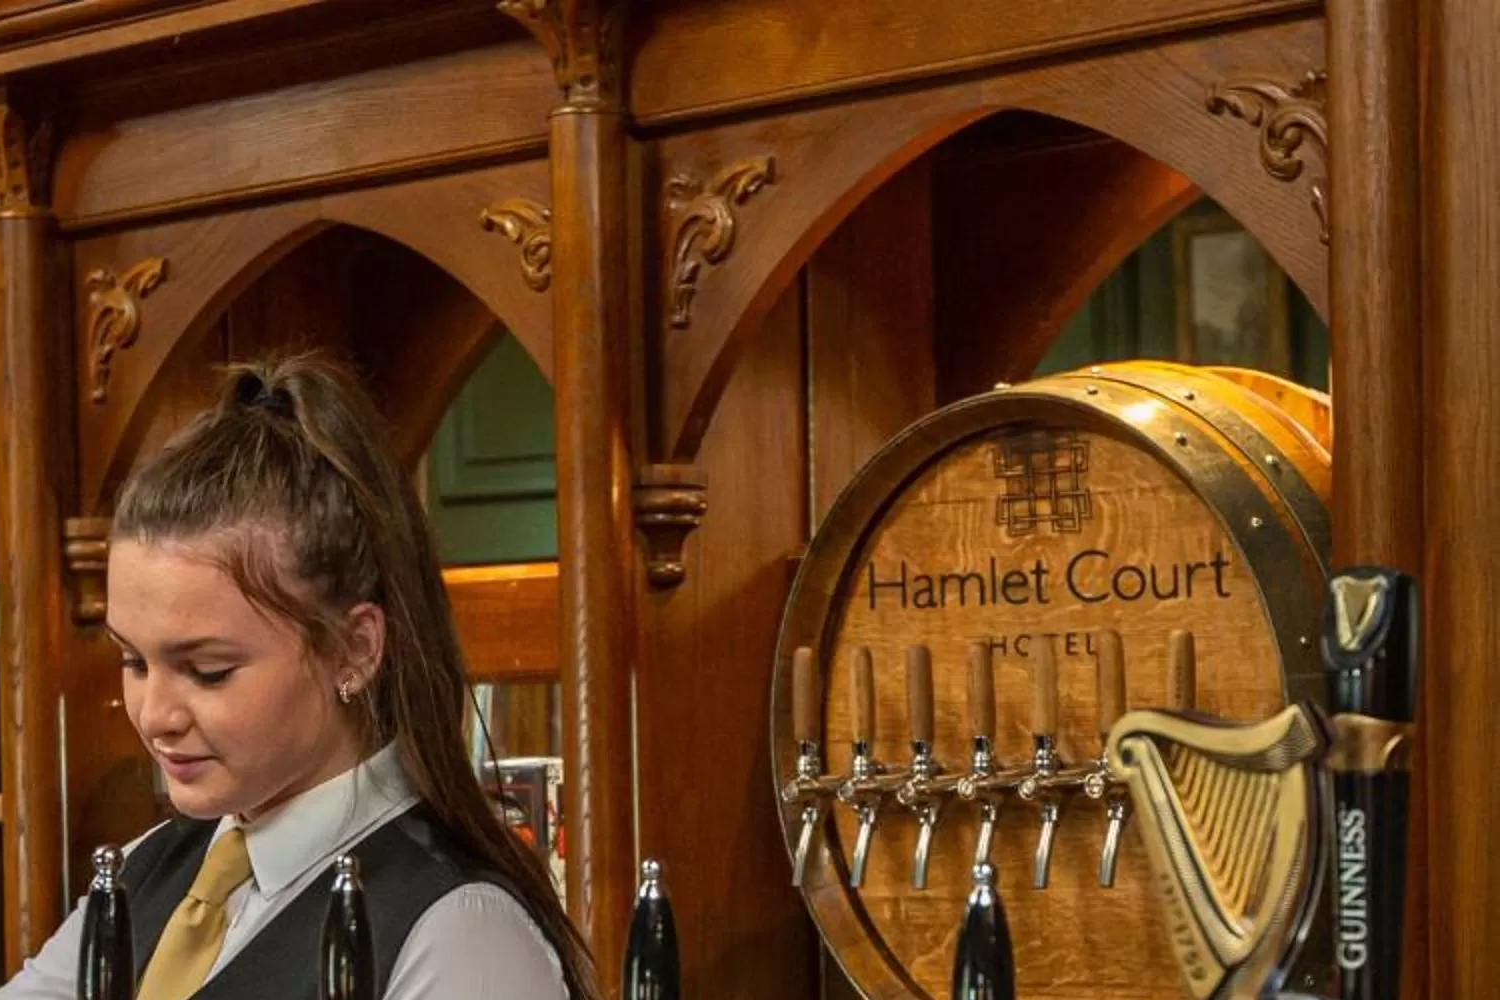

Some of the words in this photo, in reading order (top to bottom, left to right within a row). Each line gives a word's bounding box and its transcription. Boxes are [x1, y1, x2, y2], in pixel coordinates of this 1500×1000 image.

[868, 556, 1050, 610] Hamlet
[1065, 549, 1231, 602] Court
[1337, 802, 1368, 970] GUINNESS
